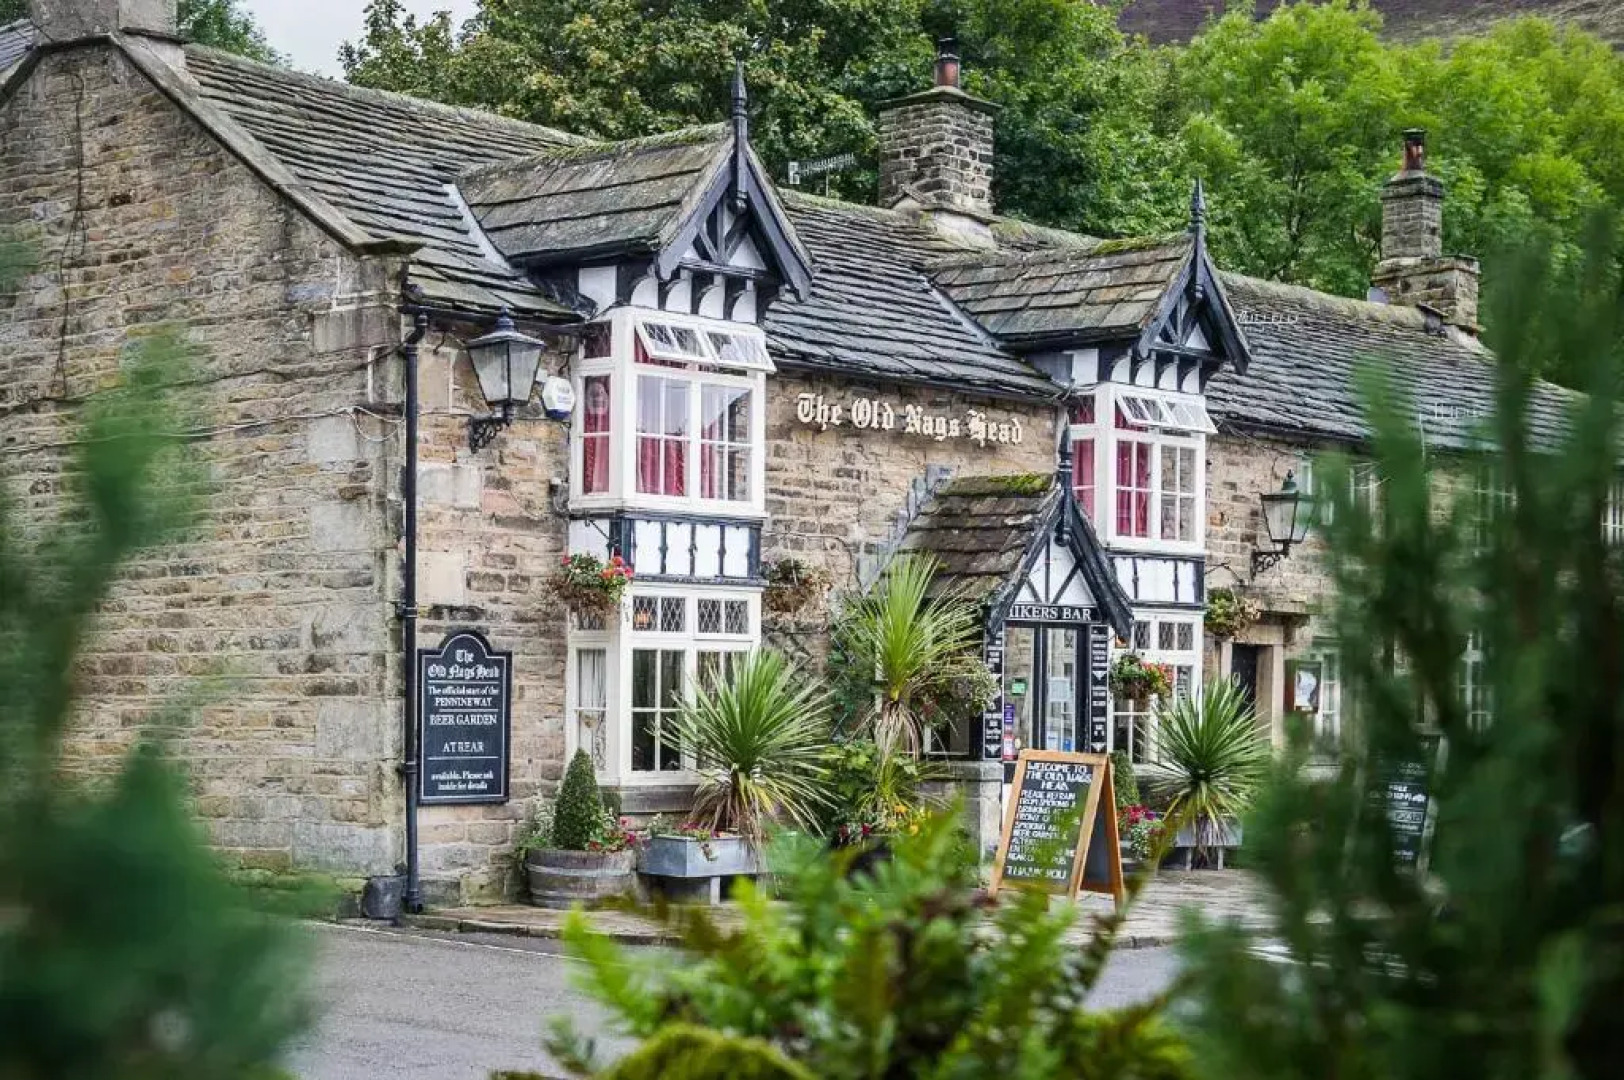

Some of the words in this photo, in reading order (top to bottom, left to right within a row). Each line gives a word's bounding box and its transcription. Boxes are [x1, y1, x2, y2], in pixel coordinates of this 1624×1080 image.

[797, 393, 842, 430] The
[851, 397, 894, 430] Old
[904, 403, 960, 441] Nags
[967, 409, 1022, 447] Head
[1062, 608, 1092, 620] BAR
[455, 649, 474, 663] The
[427, 664, 447, 678] Old
[448, 664, 475, 679] Nags
[475, 664, 500, 679] Head
[428, 685, 441, 695] The
[442, 685, 465, 695] official
[430, 714, 455, 726] BEER
[456, 714, 497, 726] GARDEN
[443, 741, 456, 753] AT
[457, 741, 484, 753] REAR
[1027, 762, 1071, 772] WELCOME
[1074, 765, 1087, 773] TO
[1026, 770, 1043, 780] THE
[1044, 771, 1064, 781] OLD
[1041, 780, 1069, 791] HEAD
